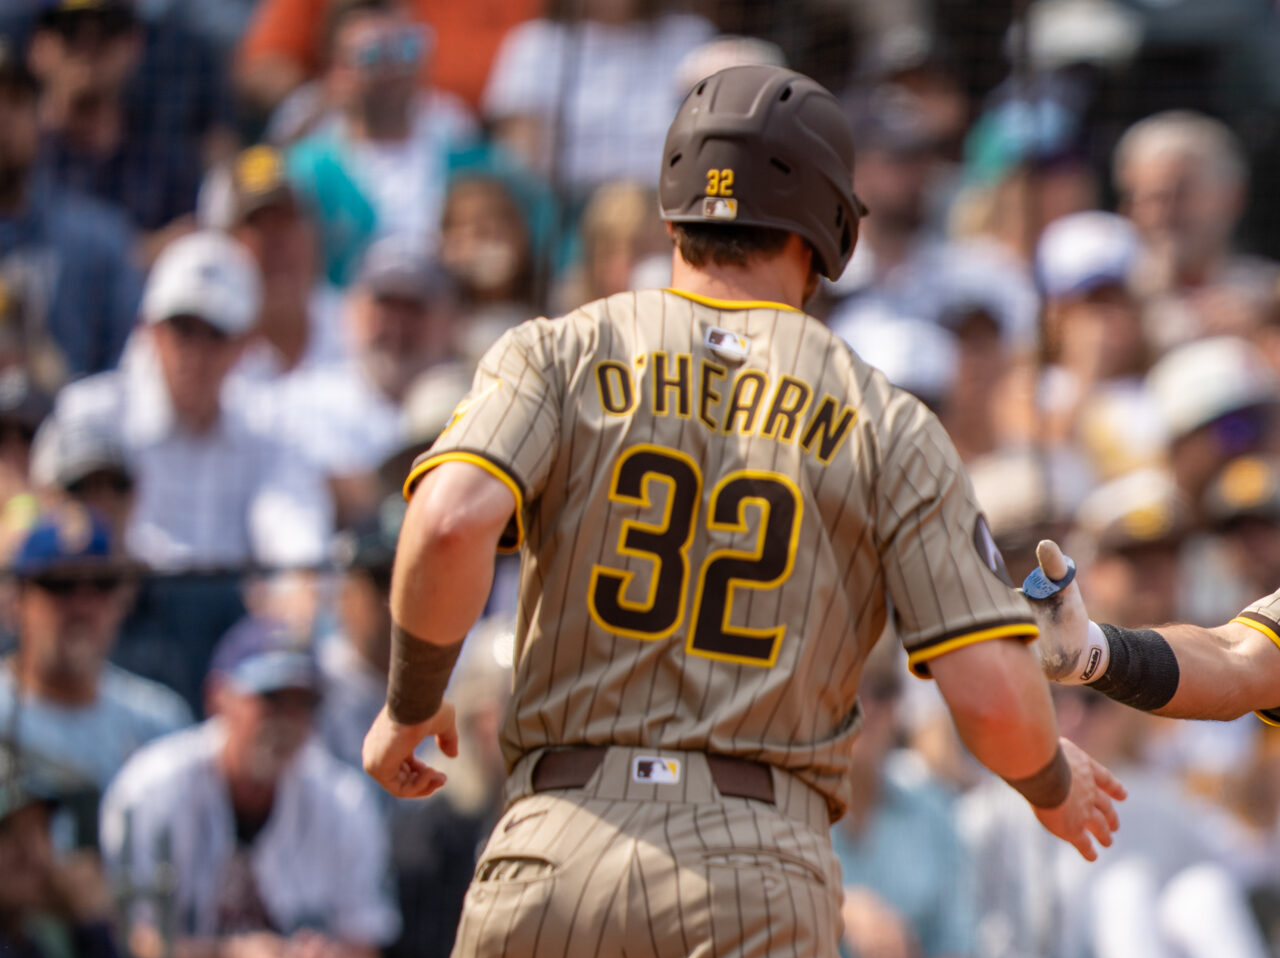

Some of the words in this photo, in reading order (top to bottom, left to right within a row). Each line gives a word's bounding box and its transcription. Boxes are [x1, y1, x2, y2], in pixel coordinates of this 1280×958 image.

[706, 168, 734, 196] 32
[595, 351, 858, 466] O'HEARN
[587, 443, 804, 669] 32
